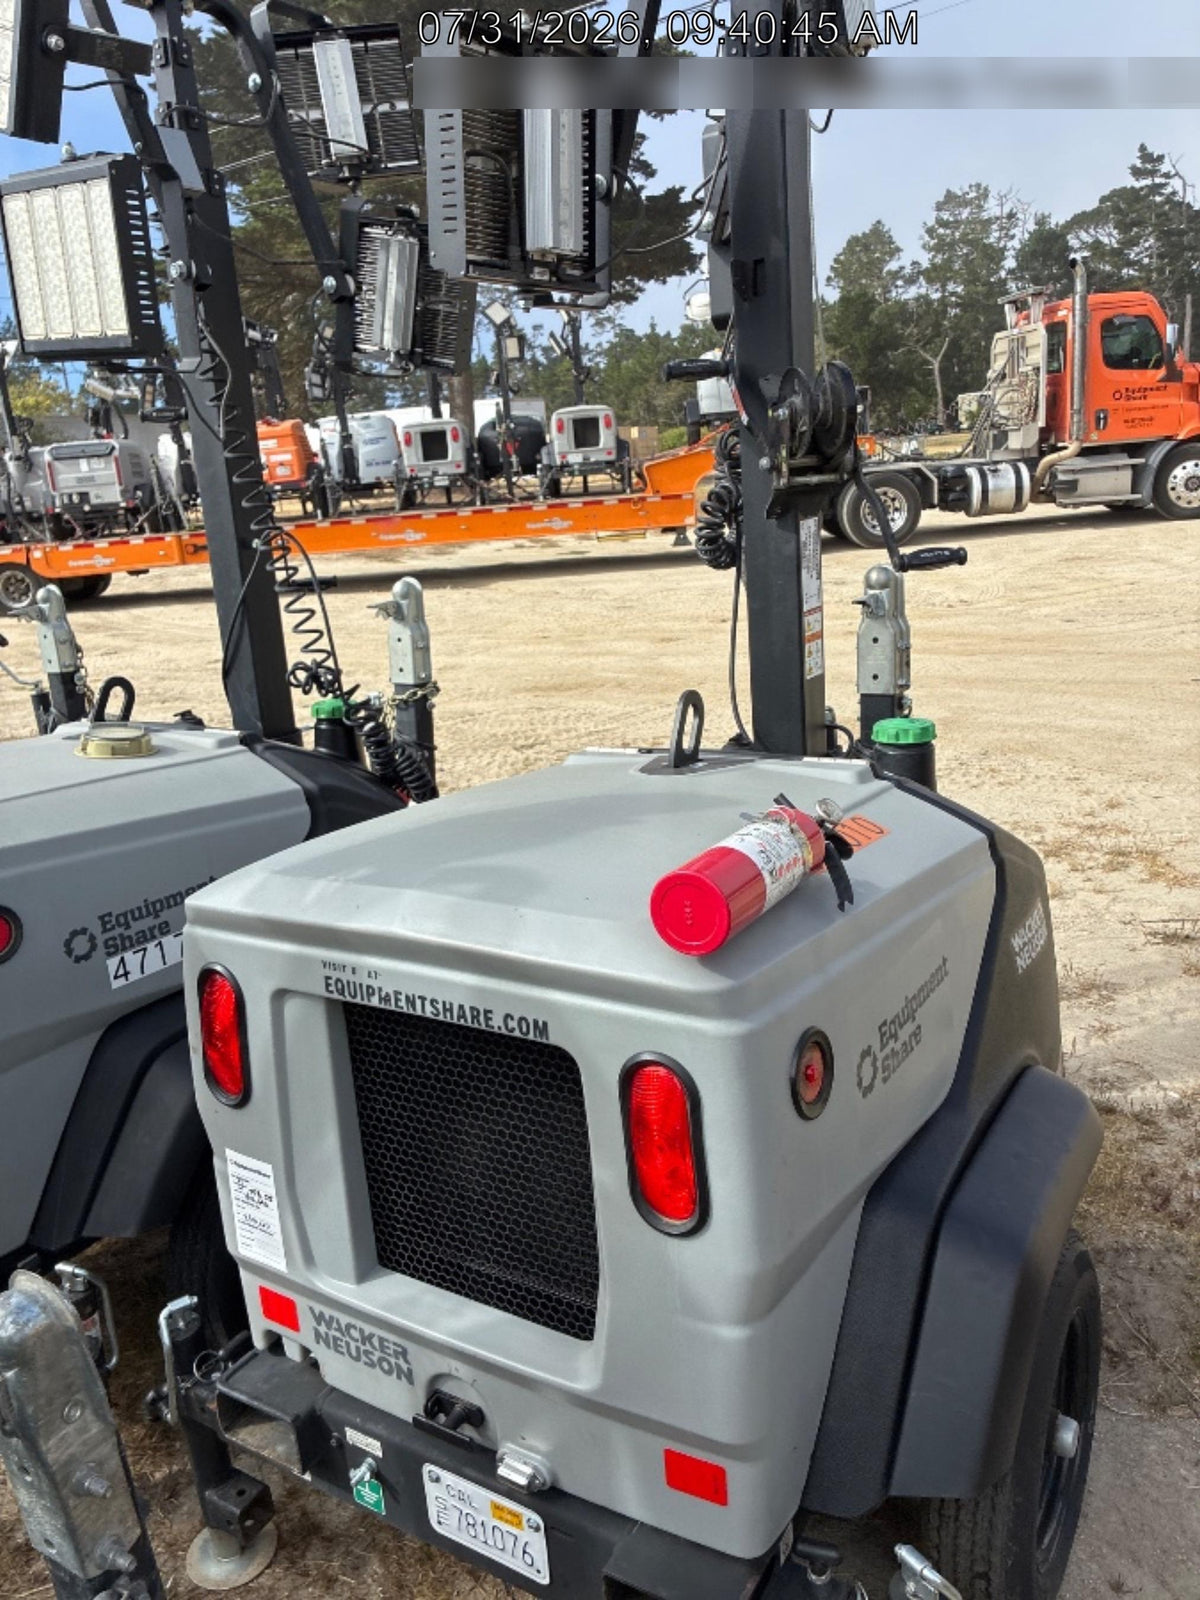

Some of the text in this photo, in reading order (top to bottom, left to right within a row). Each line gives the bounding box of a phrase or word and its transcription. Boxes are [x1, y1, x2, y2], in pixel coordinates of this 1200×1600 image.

[103, 920, 171, 957] Share
[878, 955, 950, 1052] Equipment
[881, 1024, 922, 1085] Share
[308, 1305, 412, 1366] WACKER
[313, 1326, 415, 1386] NEUSON
[451, 1503, 535, 1567] 781076
